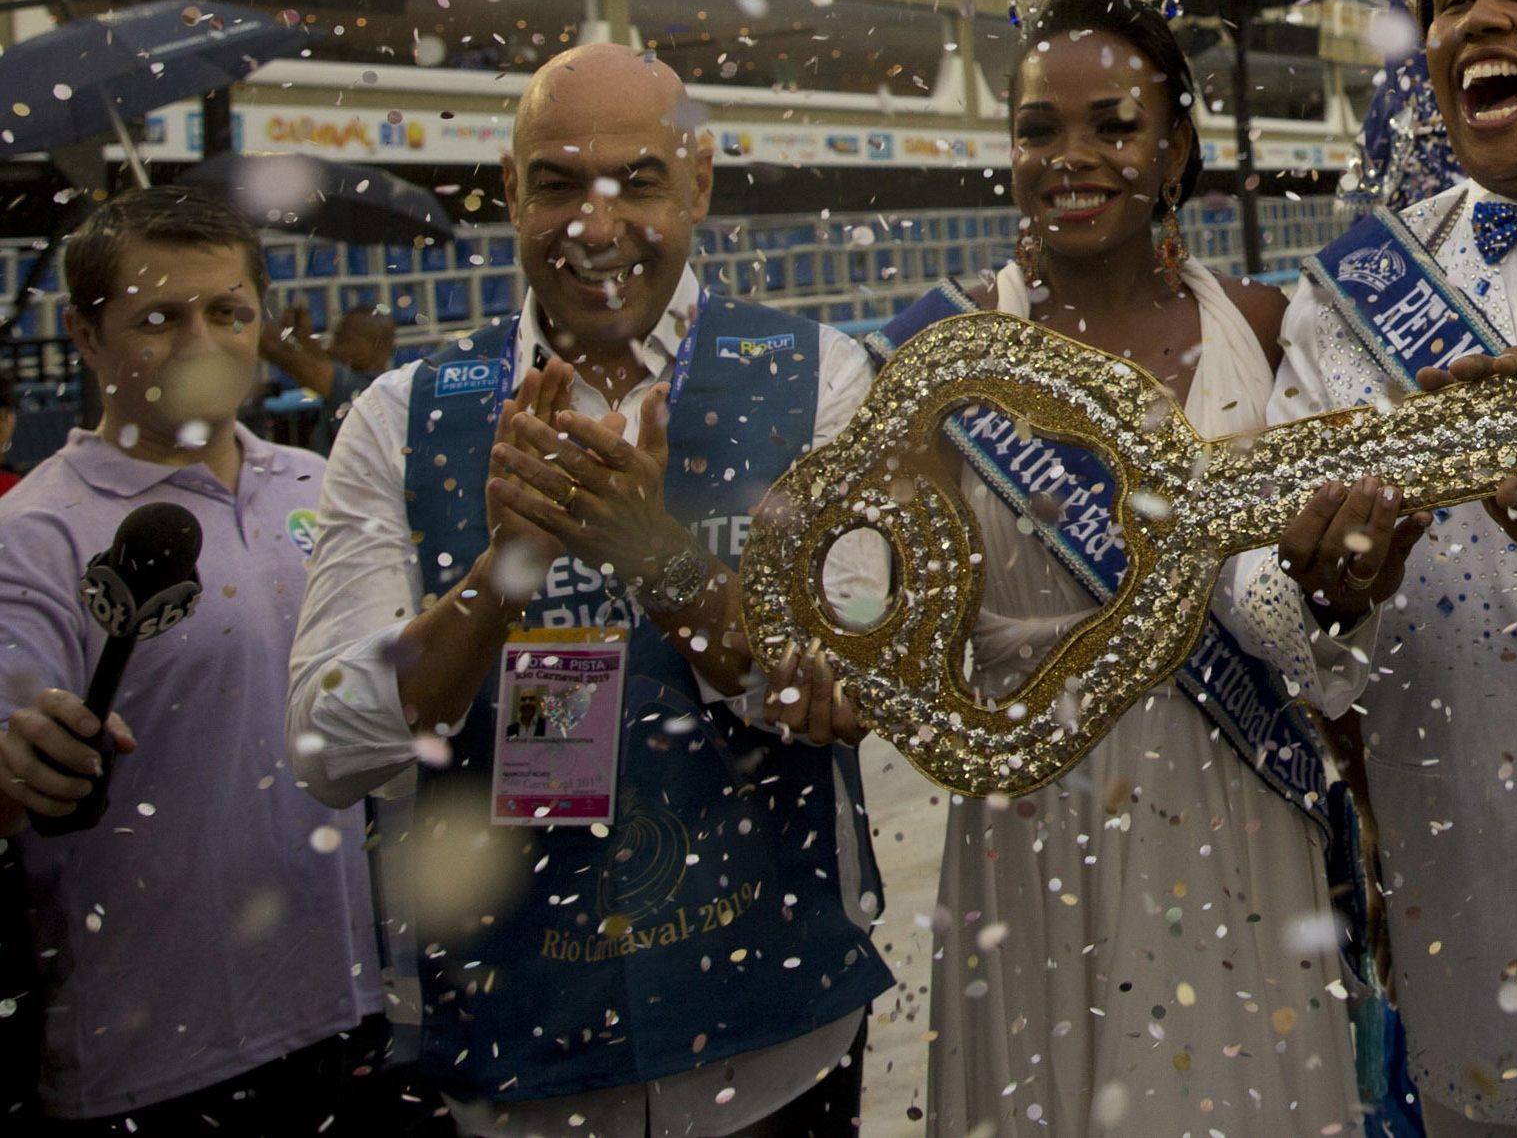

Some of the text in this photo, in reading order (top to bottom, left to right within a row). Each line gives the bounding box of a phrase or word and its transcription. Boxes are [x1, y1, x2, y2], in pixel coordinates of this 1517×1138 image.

[1373, 278, 1457, 360] REI
[443, 365, 490, 383] RIO
[570, 659, 606, 671] PISTA
[541, 928, 581, 961] Rio
[700, 881, 753, 934] 2019
